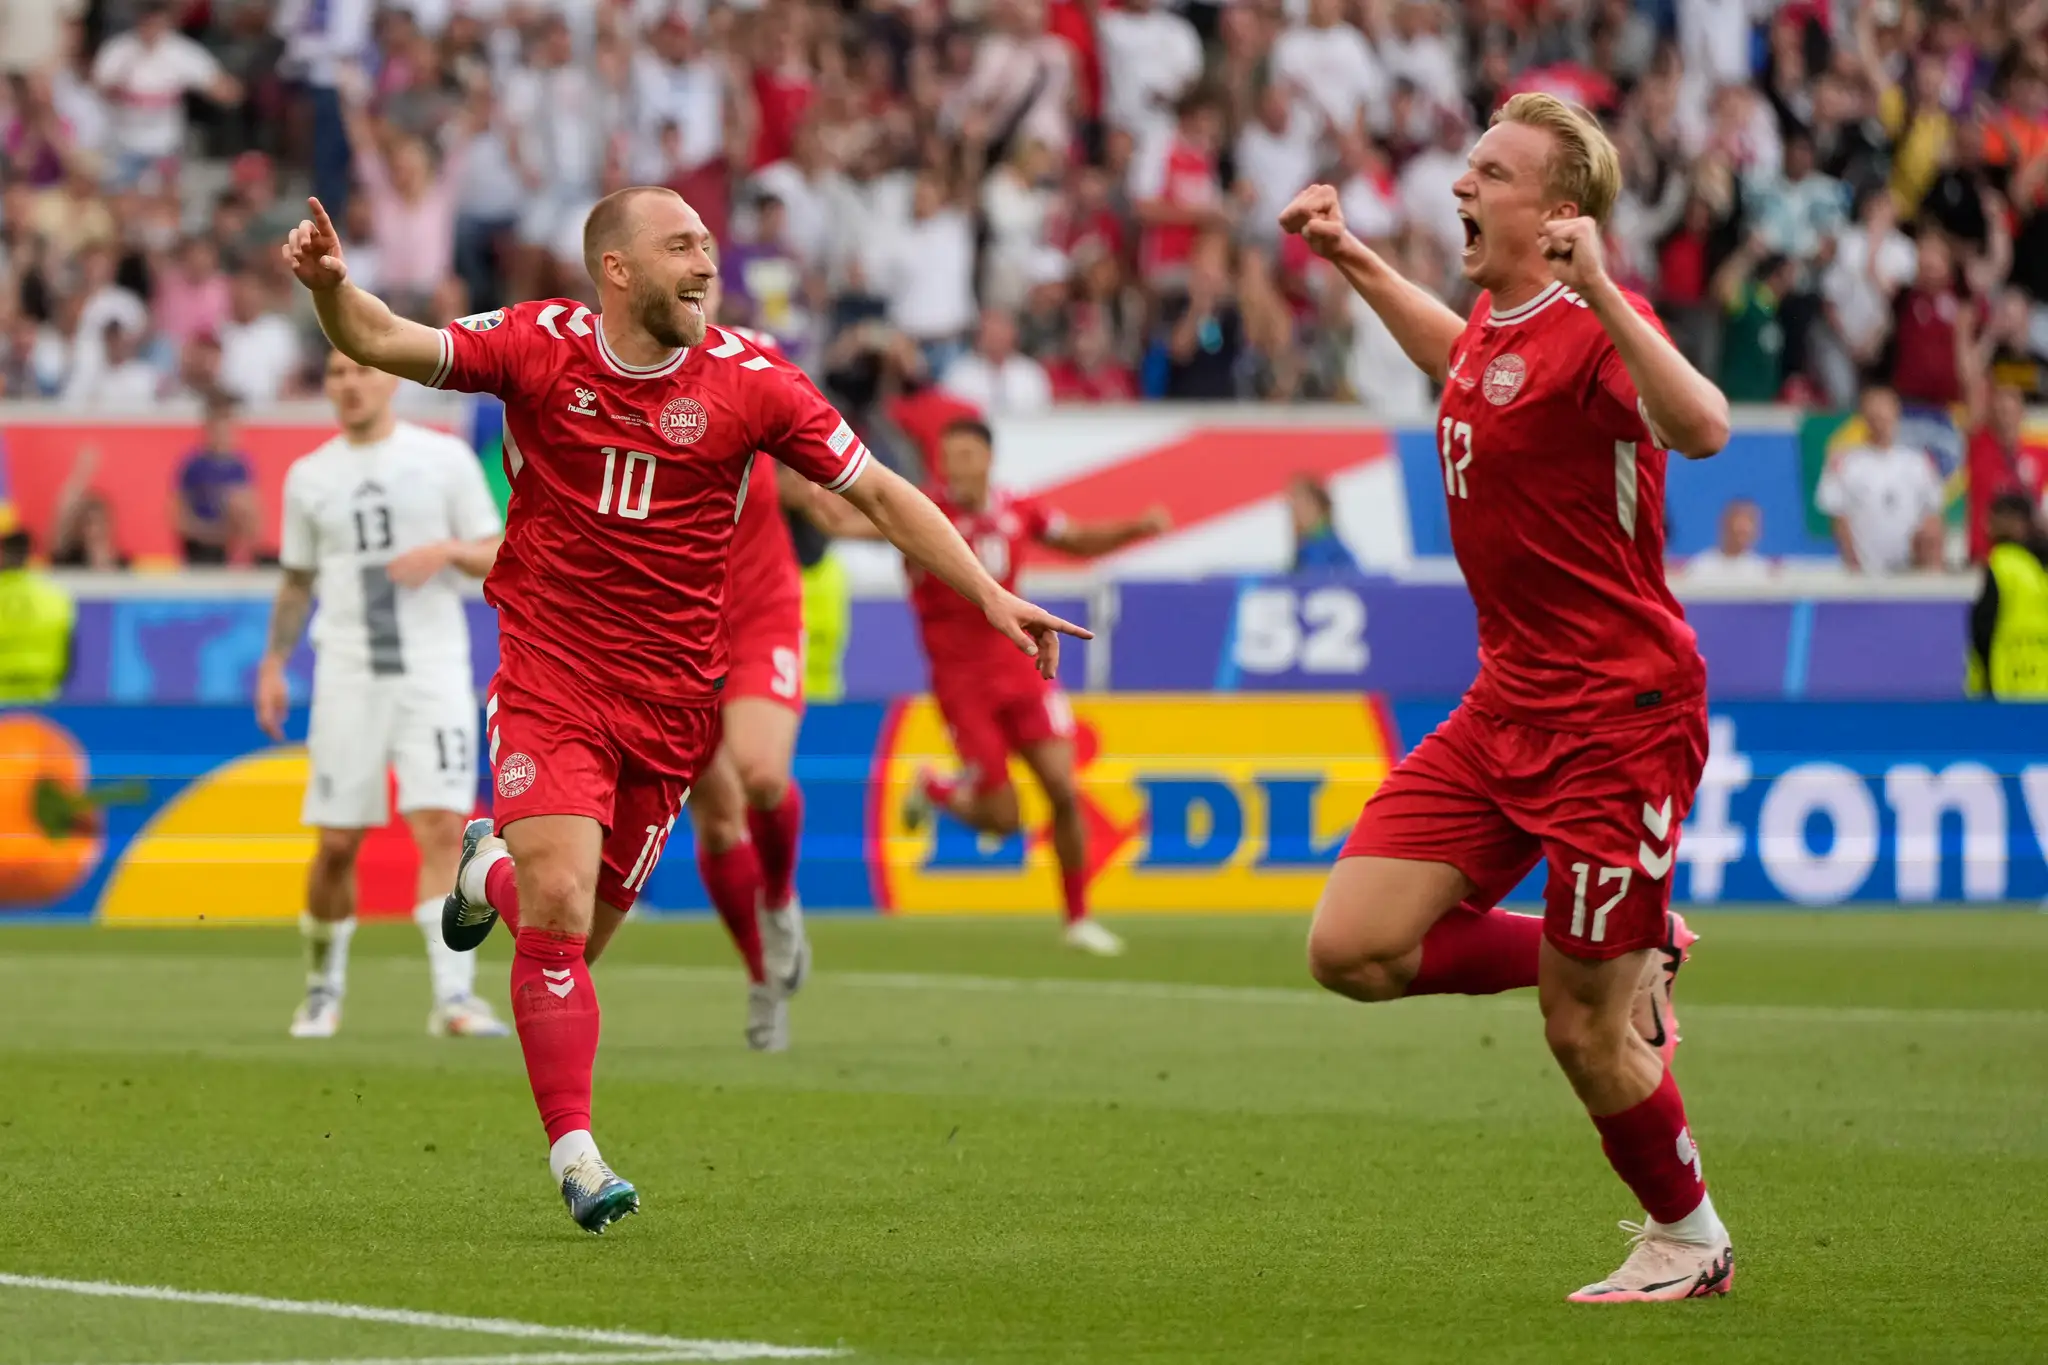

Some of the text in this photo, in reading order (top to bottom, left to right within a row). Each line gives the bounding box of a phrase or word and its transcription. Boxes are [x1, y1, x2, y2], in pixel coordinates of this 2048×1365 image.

[670, 413, 698, 428] DBU
[597, 446, 657, 520] 10
[1442, 416, 1473, 500] 17
[354, 506, 394, 552] 13
[1236, 587, 1371, 675] 52
[771, 646, 797, 699] 9
[504, 765, 527, 785] DBU
[1676, 715, 2048, 908] #on
[1570, 862, 1633, 942] 17
